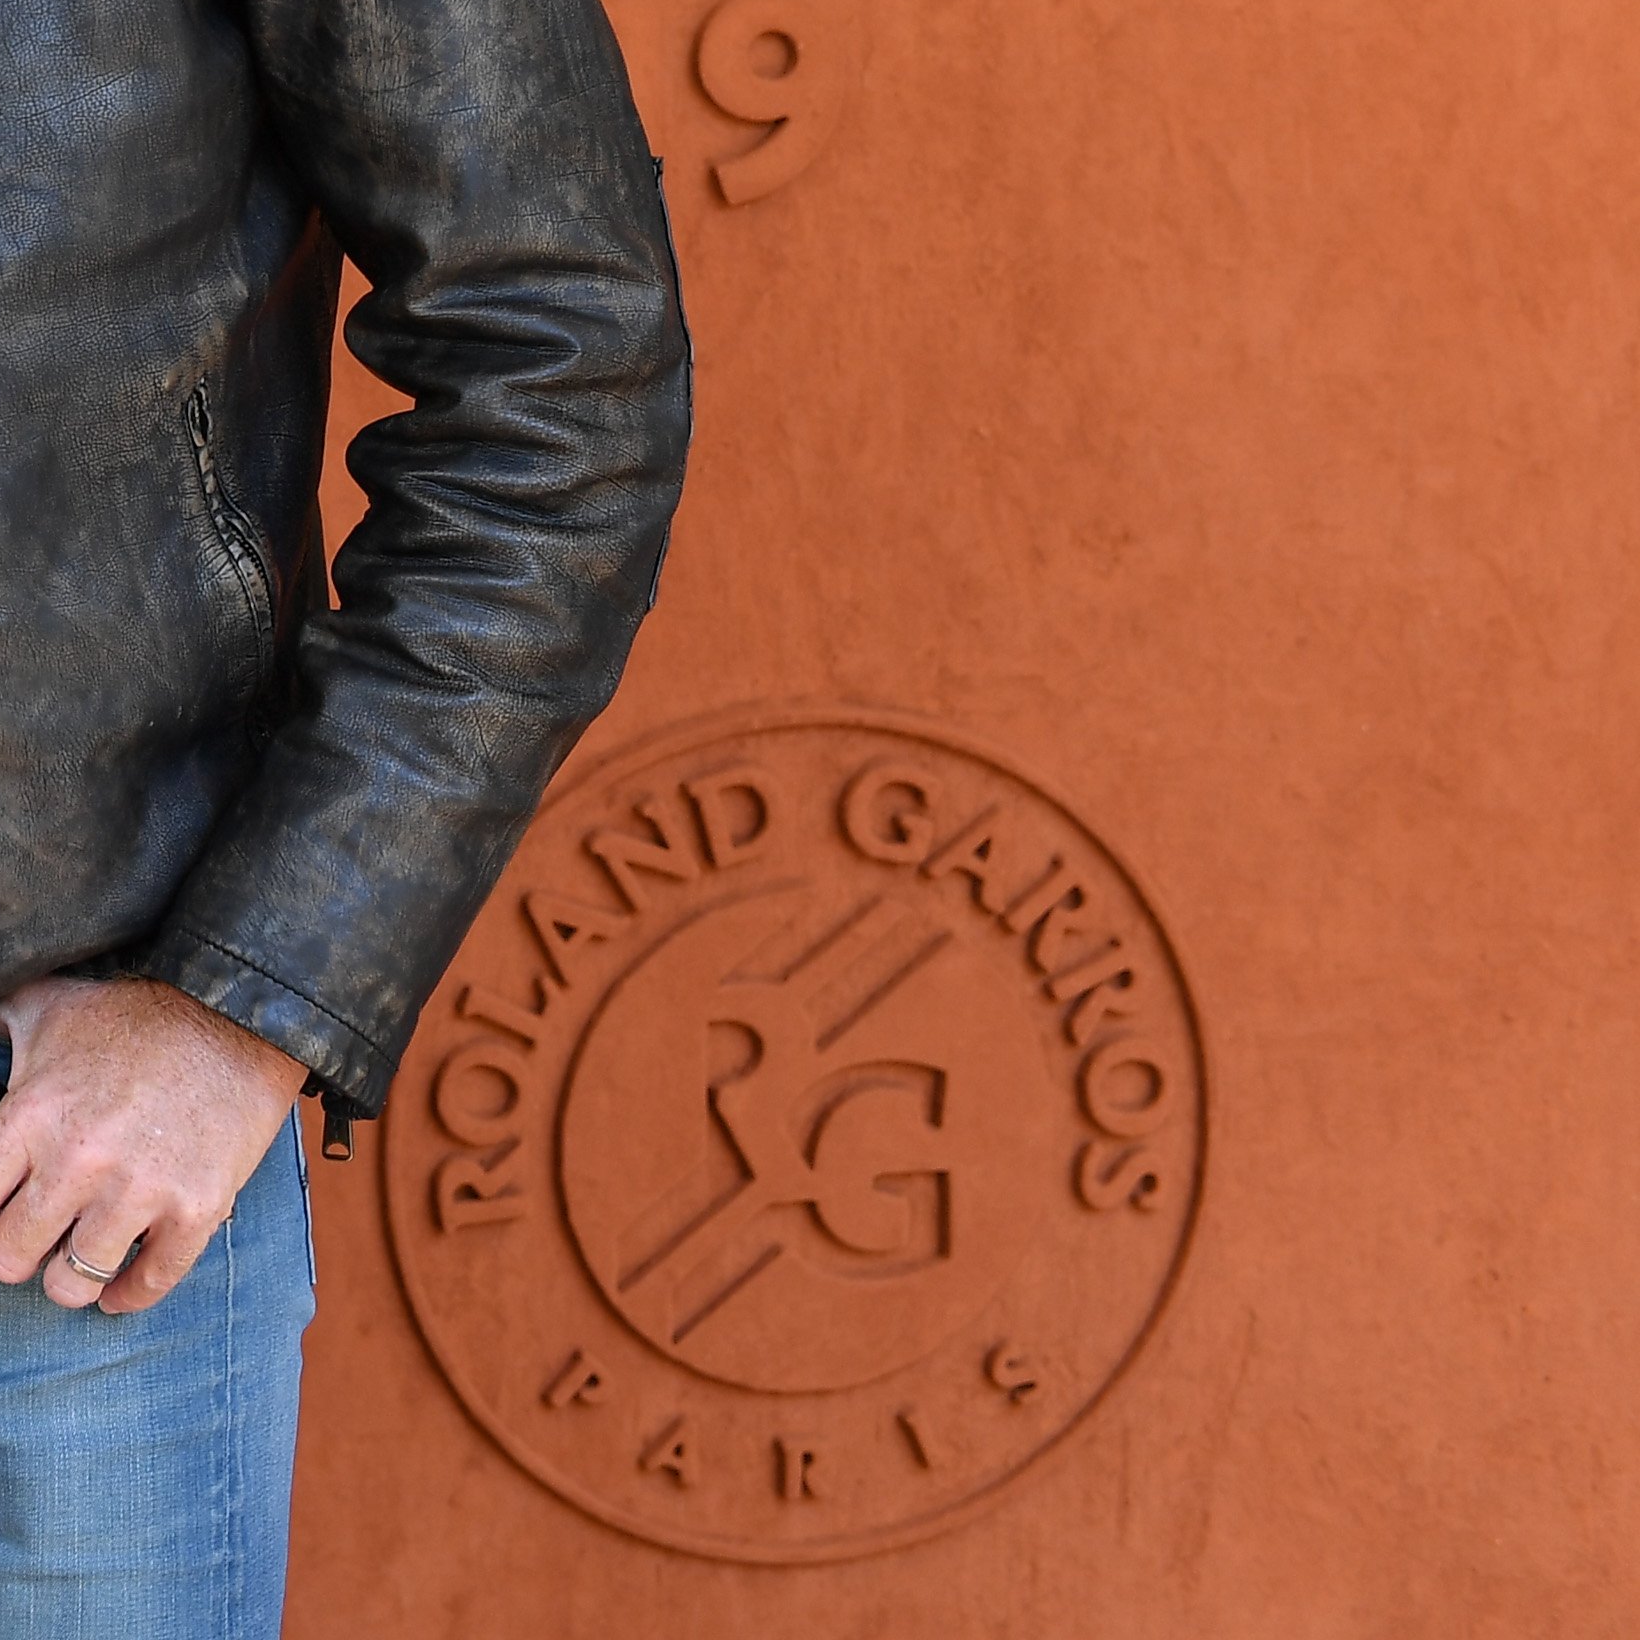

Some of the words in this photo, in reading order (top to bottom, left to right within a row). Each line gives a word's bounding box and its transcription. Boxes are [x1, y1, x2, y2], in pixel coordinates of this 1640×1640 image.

[429, 763, 774, 1236] ROLAND
[834, 758, 1174, 1218] GARROS
[543, 1333, 1044, 1503] PARIS
